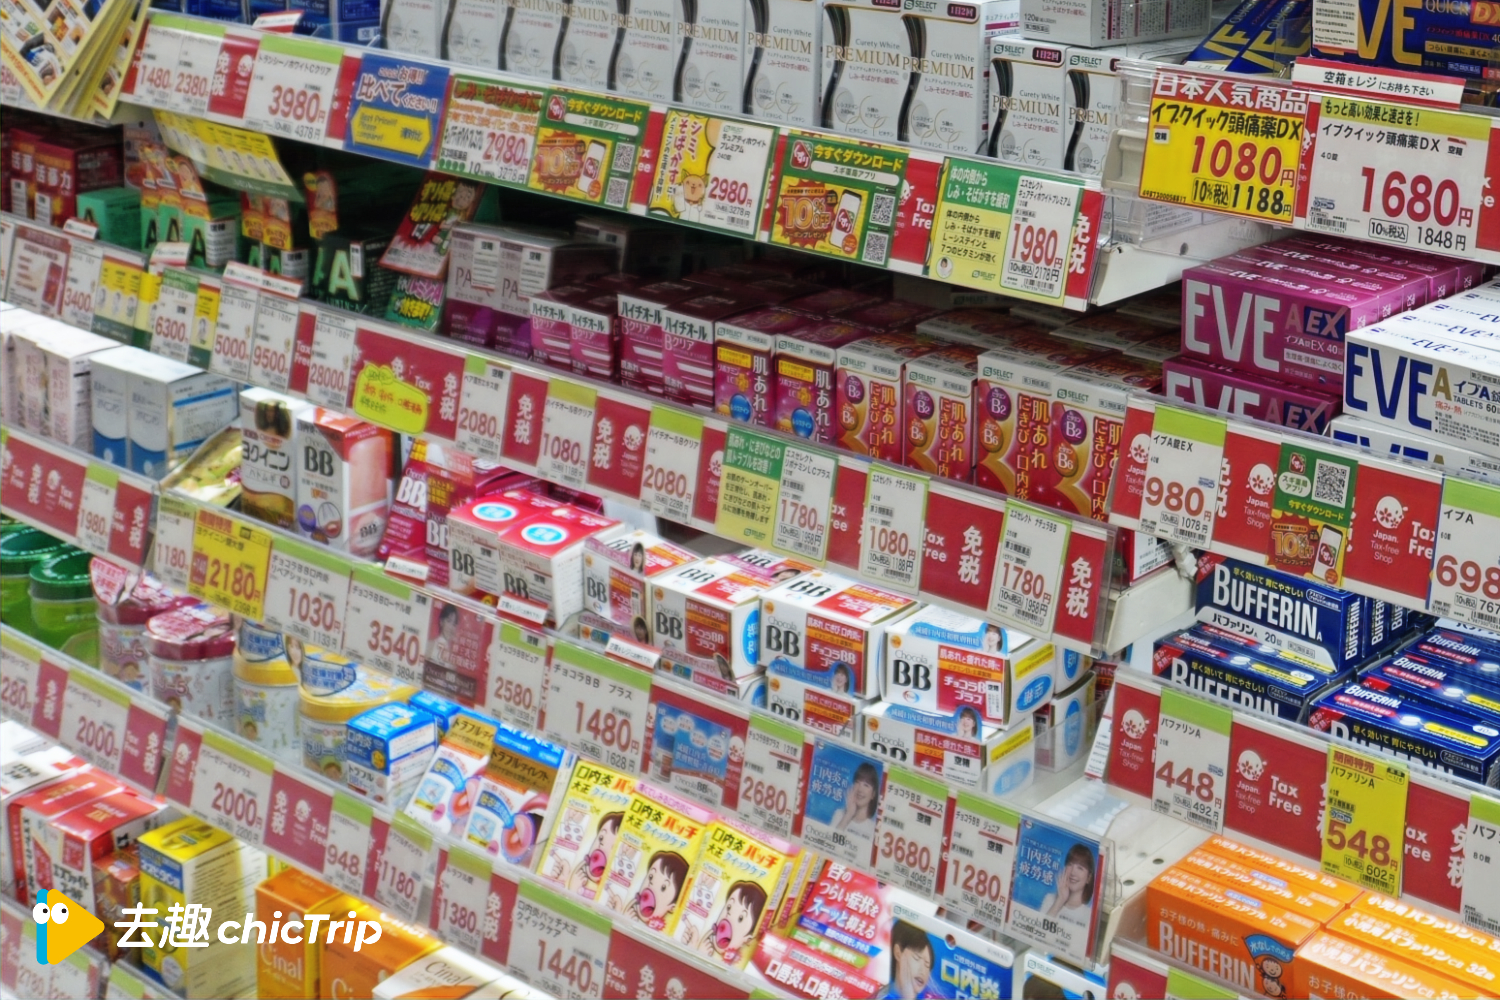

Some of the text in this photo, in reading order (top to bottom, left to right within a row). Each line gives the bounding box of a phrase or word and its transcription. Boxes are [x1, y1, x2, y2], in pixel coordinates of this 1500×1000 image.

[747, 32, 812, 55] PREMIUM
[825, 45, 900, 67] PREMIUM
[1153, 72, 1307, 114] 日本人気商品
[1184, 279, 1280, 373] EVE
[1213, 563, 1317, 642] BUFFERIN
